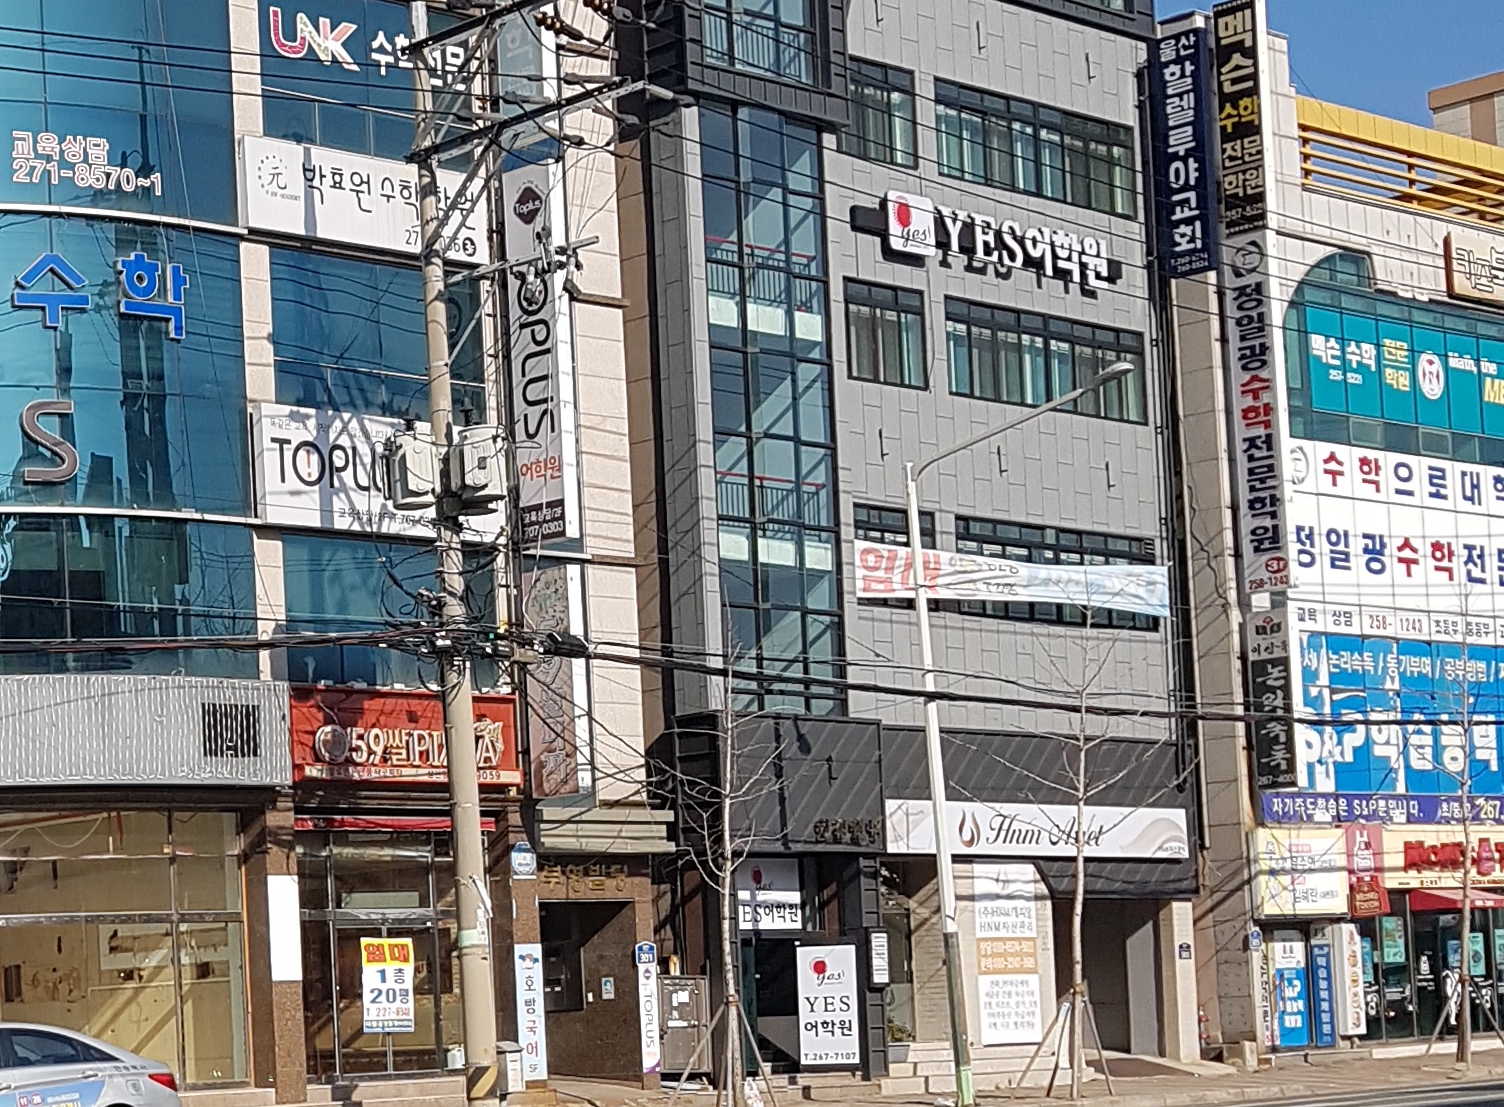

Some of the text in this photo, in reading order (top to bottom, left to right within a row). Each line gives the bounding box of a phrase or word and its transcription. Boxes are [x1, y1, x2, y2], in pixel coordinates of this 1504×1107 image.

[269, 5, 361, 72] UNK
[1216, 8, 1255, 94] 멕슨
[1219, 95, 1261, 133] 수학
[11, 129, 110, 165] 교육상담
[1163, 60, 1202, 252] 할렐루야교회
[1222, 134, 1262, 168] 전문
[12, 161, 163, 196] 271-8570~1
[302, 162, 373, 213] 박효원
[1223, 168, 1265, 197] 학원
[517, 270, 556, 441] OPLUS
[1346, 341, 1377, 372] 수학
[1384, 368, 1411, 391] 학원
[520, 454, 562, 482] 어학원
[1297, 606, 1318, 624] 교육
[1331, 609, 1353, 627] 상담
[364, 943, 410, 963] 임대
[639, 953, 654, 962] 301
[376, 968, 405, 984] 1층
[369, 987, 409, 1004] 20평
[804, 995, 852, 1014] YES
[523, 974, 539, 1057] 호빵국어
[643, 992, 655, 1049] TOPLUS
[804, 1019, 854, 1038] 어학원
[803, 1051, 857, 1062] T.267-7107
